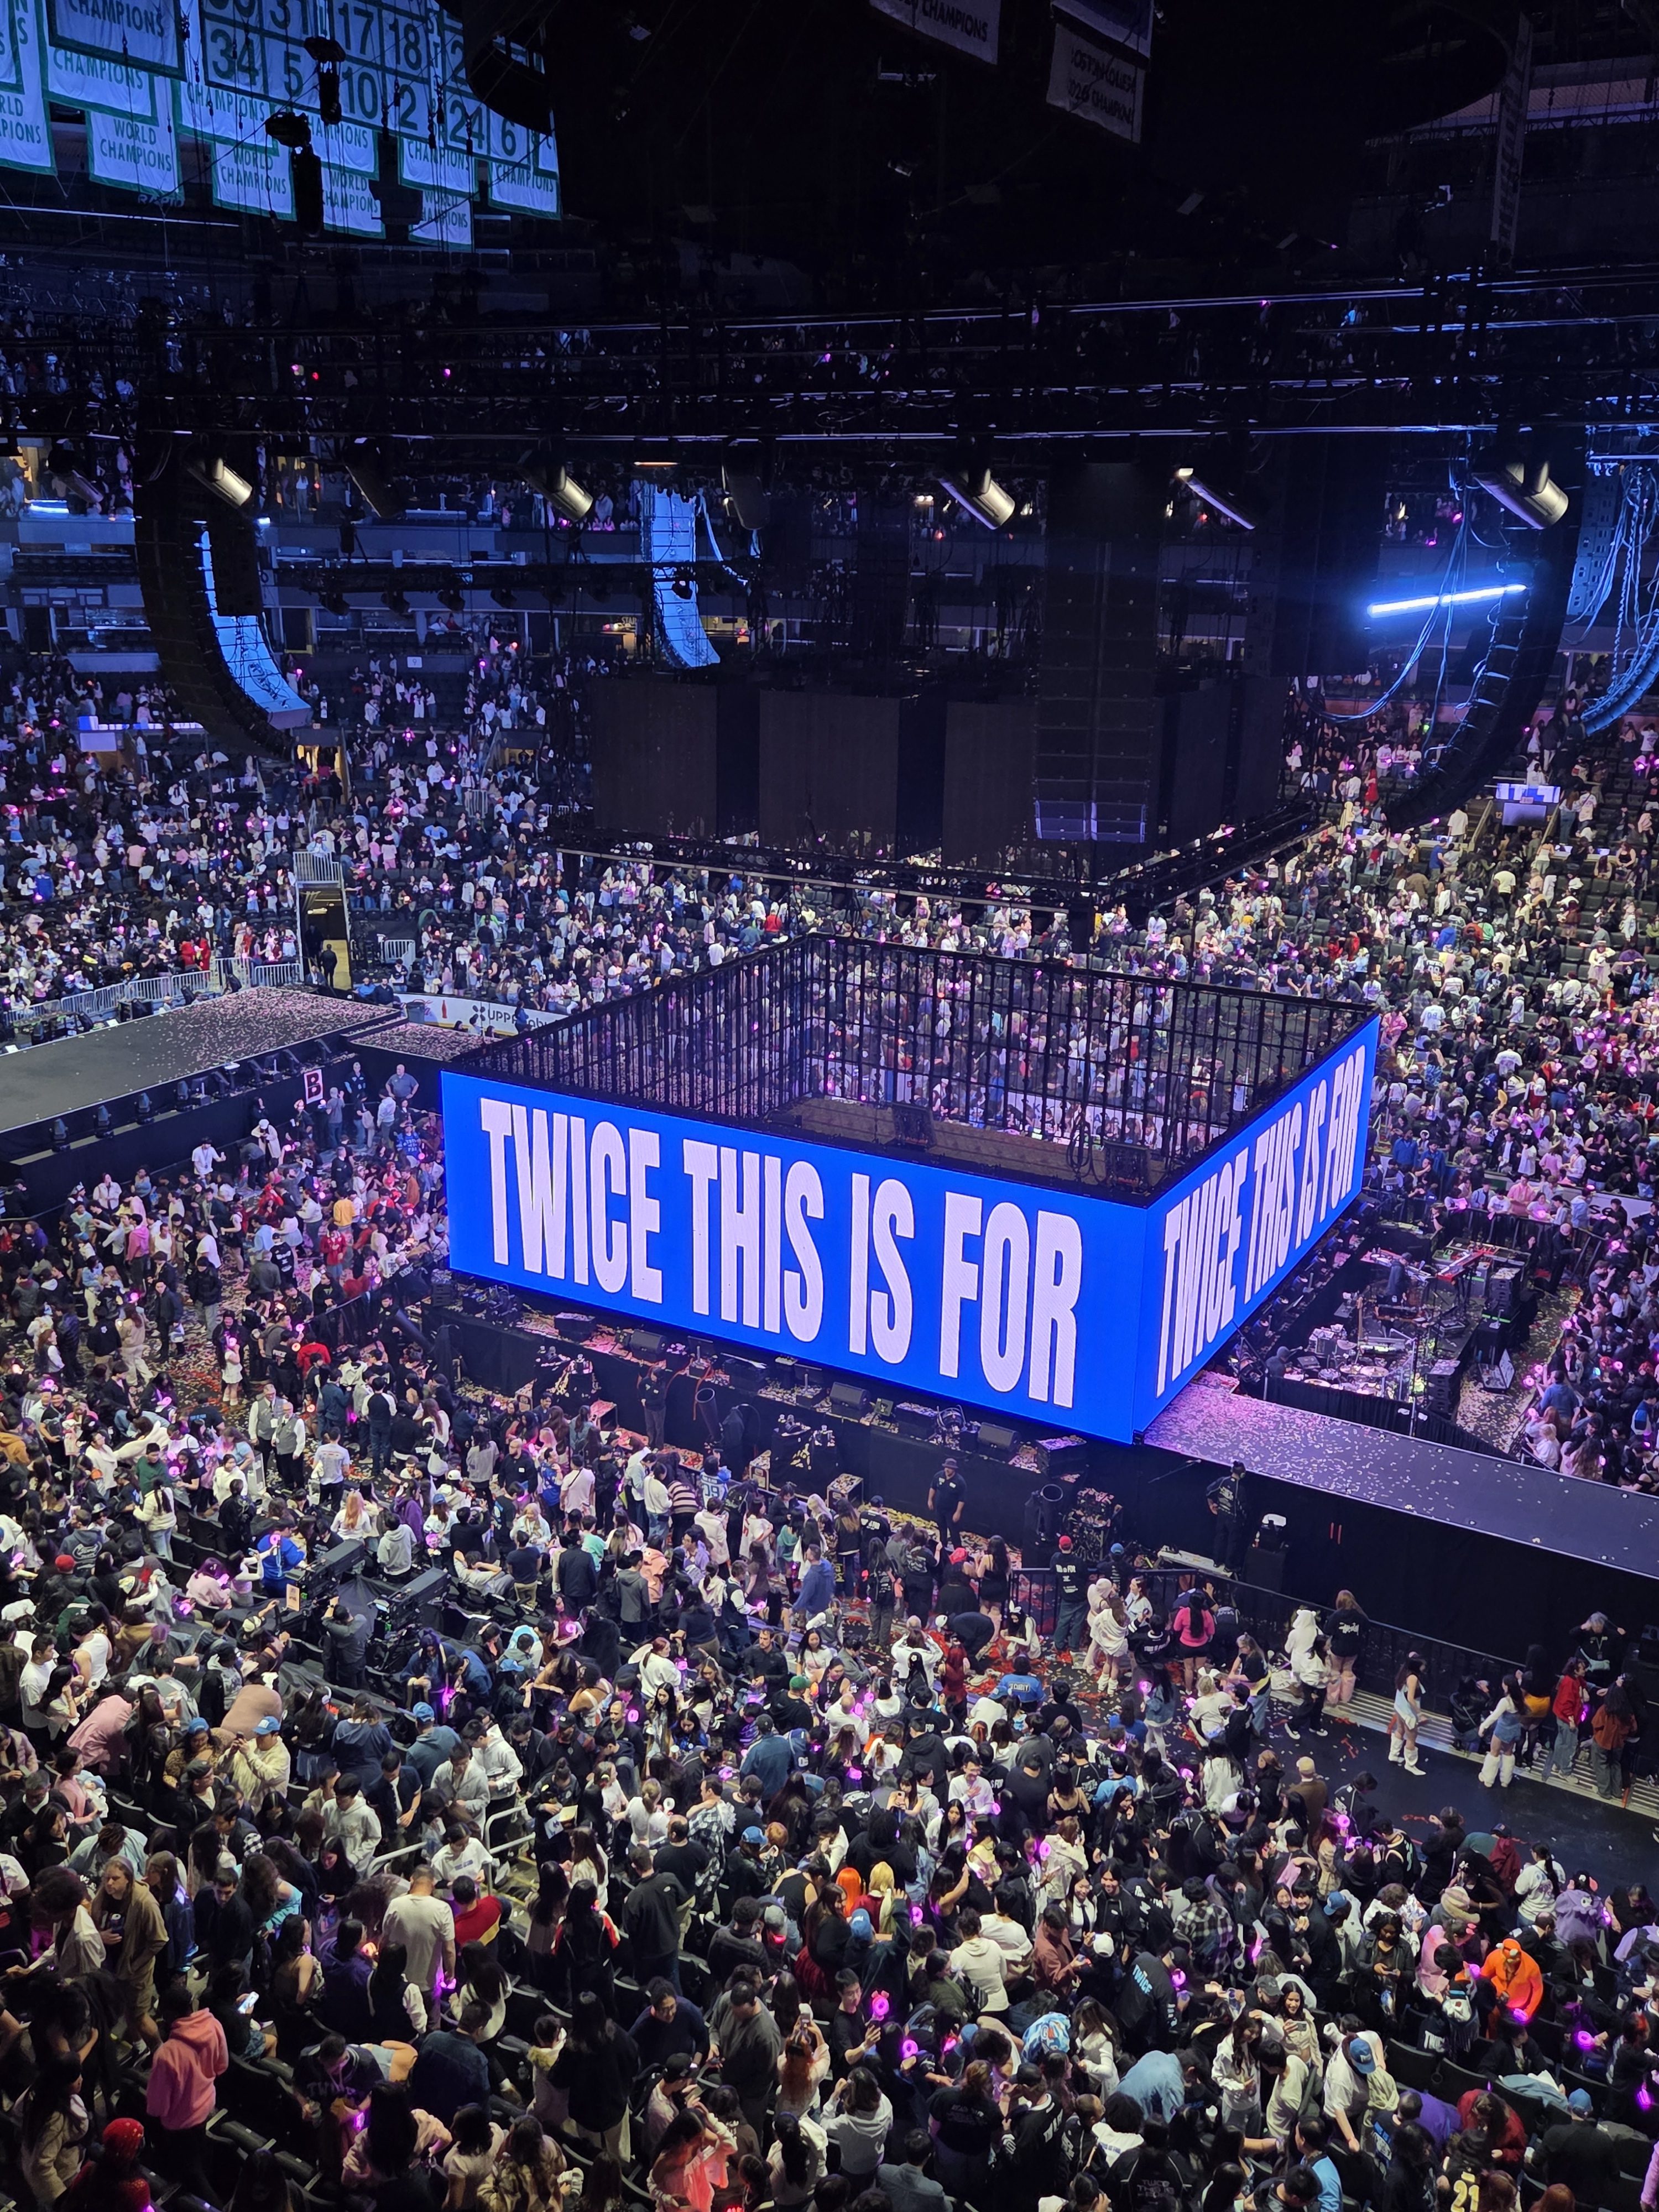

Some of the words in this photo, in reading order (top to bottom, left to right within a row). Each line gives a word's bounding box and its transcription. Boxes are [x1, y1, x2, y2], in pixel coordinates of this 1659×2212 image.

[67, 0, 164, 37] CHAMPIONS
[338, 2, 374, 55] 17
[922, 0, 988, 42] CHAMPIONS
[211, 29, 259, 85] 34
[389, 18, 422, 70] 18
[451, 40, 465, 83] 2
[54, 49, 143, 90] CHAMPIONS
[284, 51, 303, 97] 5
[0, 95, 23, 117] RLD
[187, 82, 266, 122] CHAMPIONS
[342, 65, 378, 119] 10
[399, 84, 418, 131] 2
[0, 118, 41, 144] PIONS
[113, 118, 156, 145] WORLD
[308, 114, 368, 148] HAMPIONS
[450, 100, 484, 149] 24
[502, 117, 516, 156] 6
[100, 138, 172, 171] CHAMPIONS
[233, 149, 273, 170] WORLD
[221, 166, 286, 194] CHAMPIONS
[332, 171, 367, 191] WORLD
[496, 165, 553, 192] CHAMPIONS
[422, 206, 468, 228] HAMPIONS
[306, 1073, 321, 1099] B
[1156, 1146, 1249, 1398] TWICE
[1244, 1102, 1303, 1304] THIS
[1295, 1079, 1327, 1249] IS
[1319, 1045, 1365, 1223] FOR
[480, 1098, 662, 1303] TWICE
[682, 1139, 824, 1342] THIS
[849, 1172, 914, 1364] IS
[940, 1191, 1082, 1408] FOR
[1133, 1964, 1154, 1995] TWICE
[1451, 2179, 1480, 2212] 21
